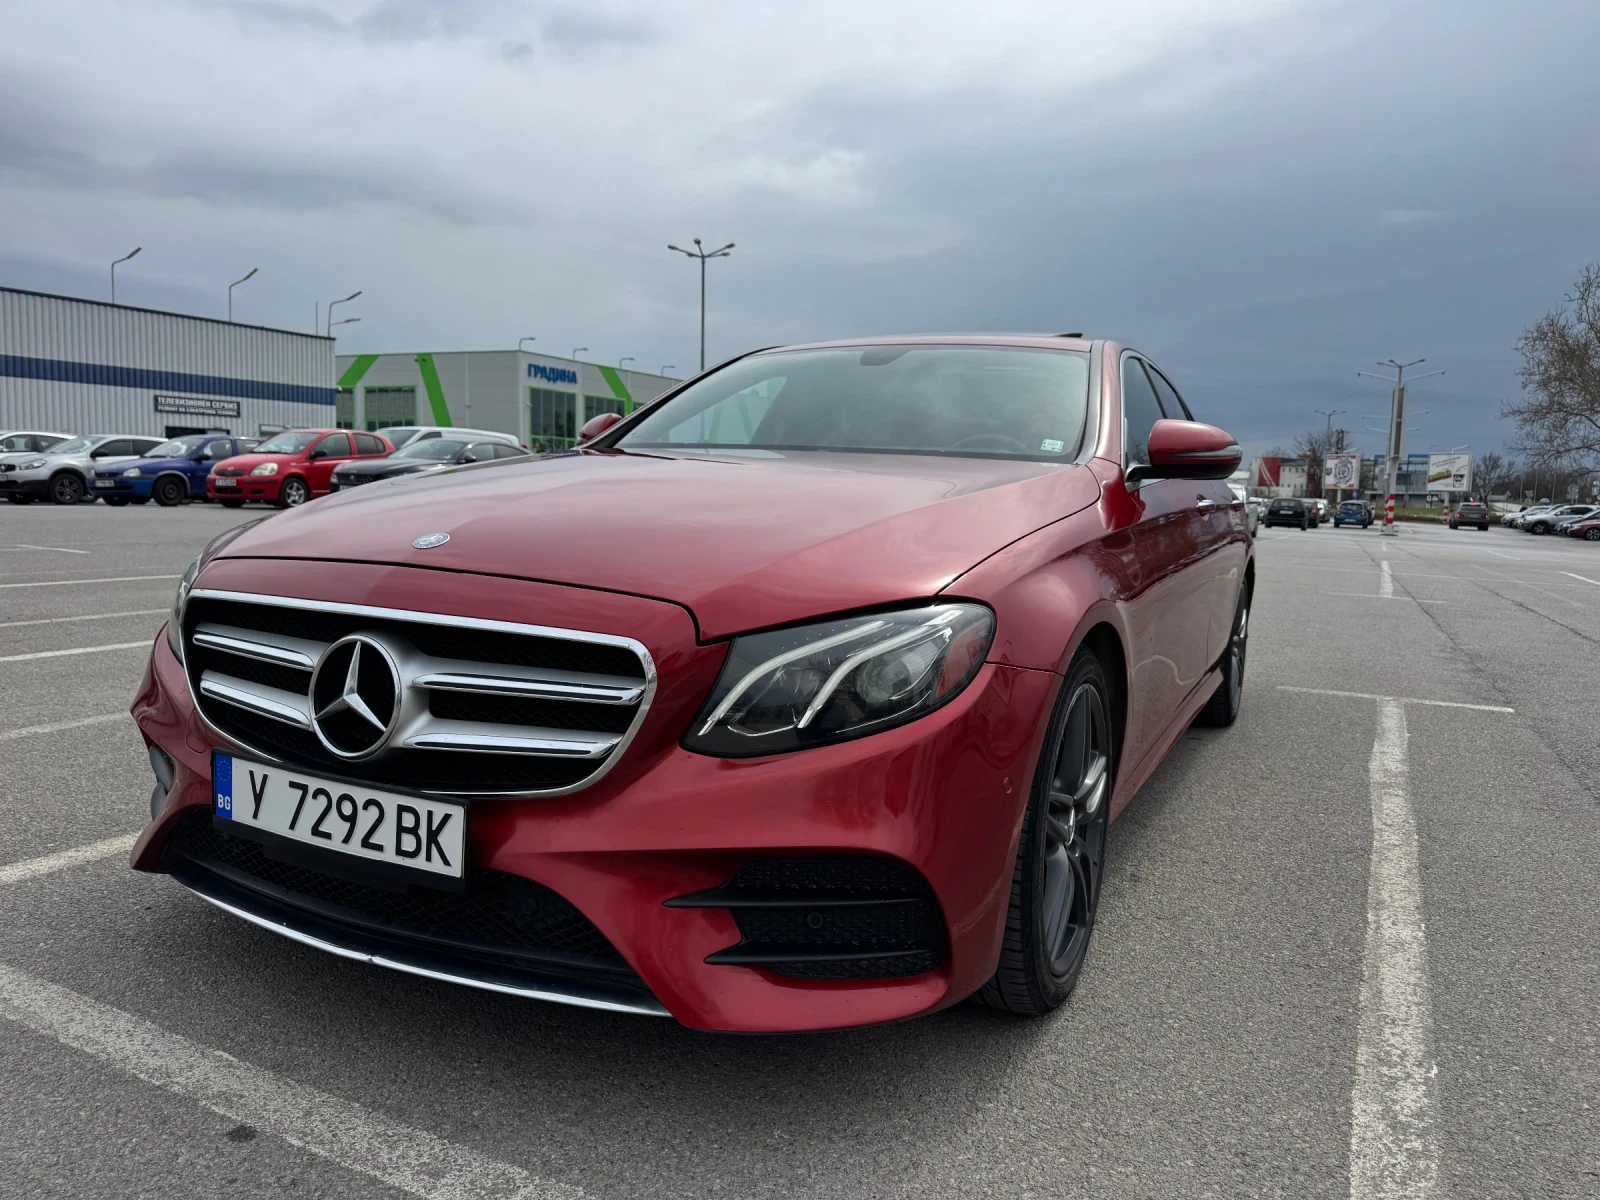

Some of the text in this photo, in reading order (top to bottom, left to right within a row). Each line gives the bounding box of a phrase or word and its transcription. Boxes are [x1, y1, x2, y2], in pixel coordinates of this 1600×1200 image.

[528, 363, 578, 384] ГРАДИНА
[211, 401, 238, 409] СЕРВИЗ
[217, 793, 231, 811] BG
[288, 780, 385, 853] 7292
[395, 803, 453, 868] BK
